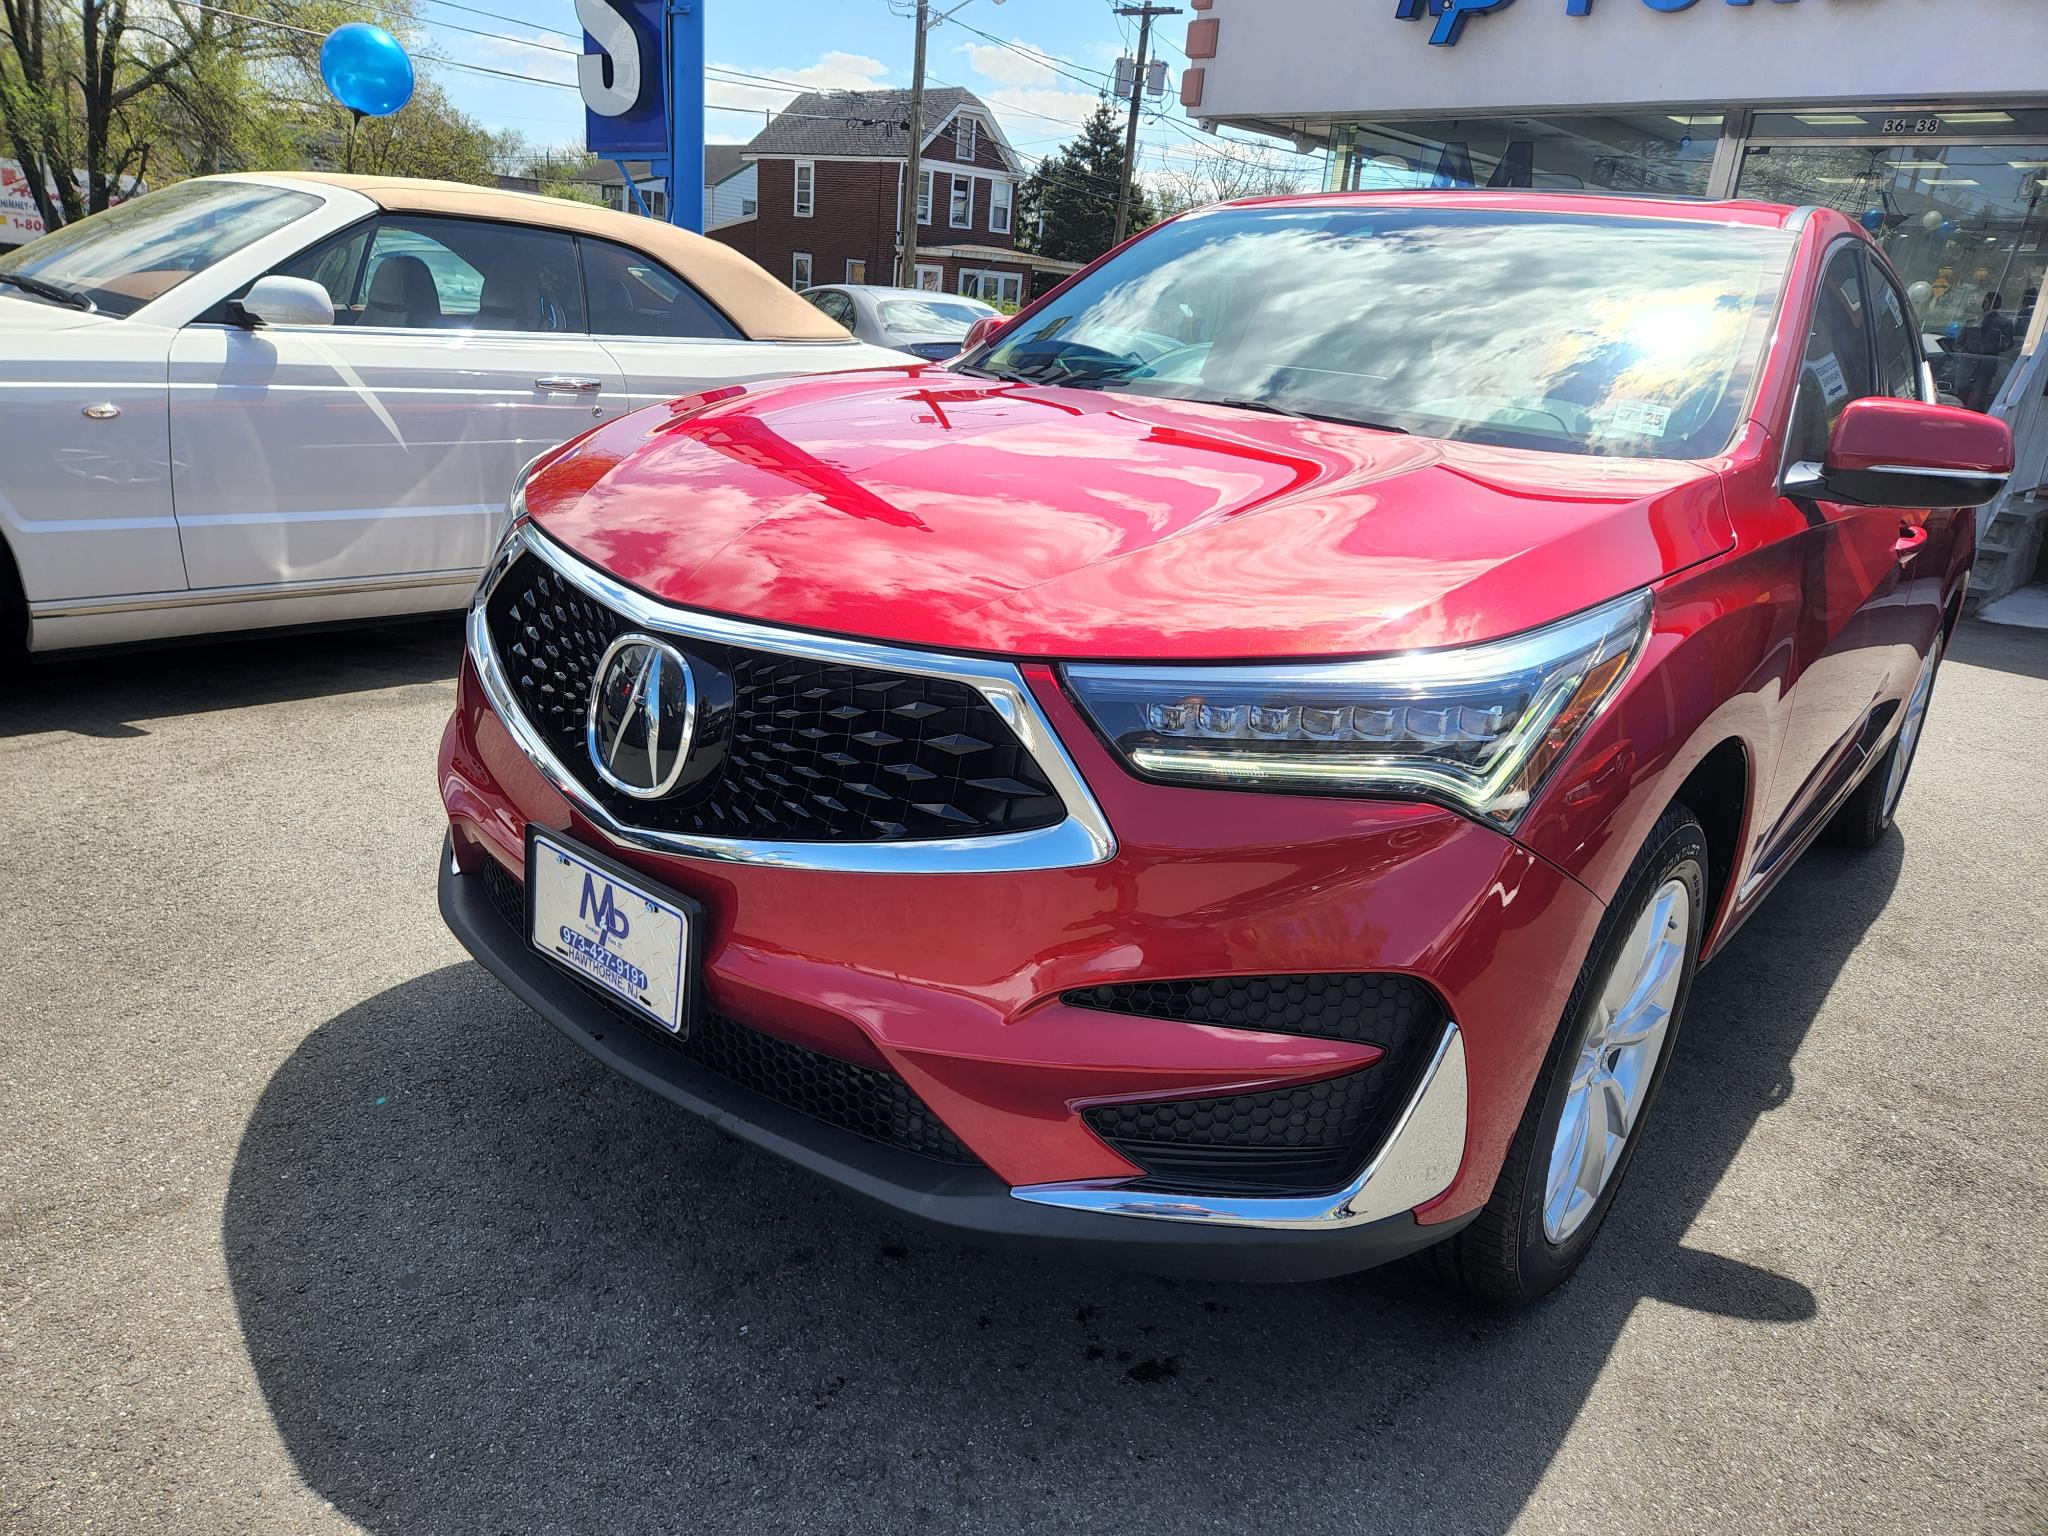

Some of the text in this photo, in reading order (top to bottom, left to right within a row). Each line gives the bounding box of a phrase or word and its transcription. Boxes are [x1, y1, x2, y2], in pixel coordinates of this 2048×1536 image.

[1884, 120, 1938, 132] 36-38
[563, 927, 646, 990] 973-427-9191
[568, 946, 640, 999] HAWTHORNE, NJ
